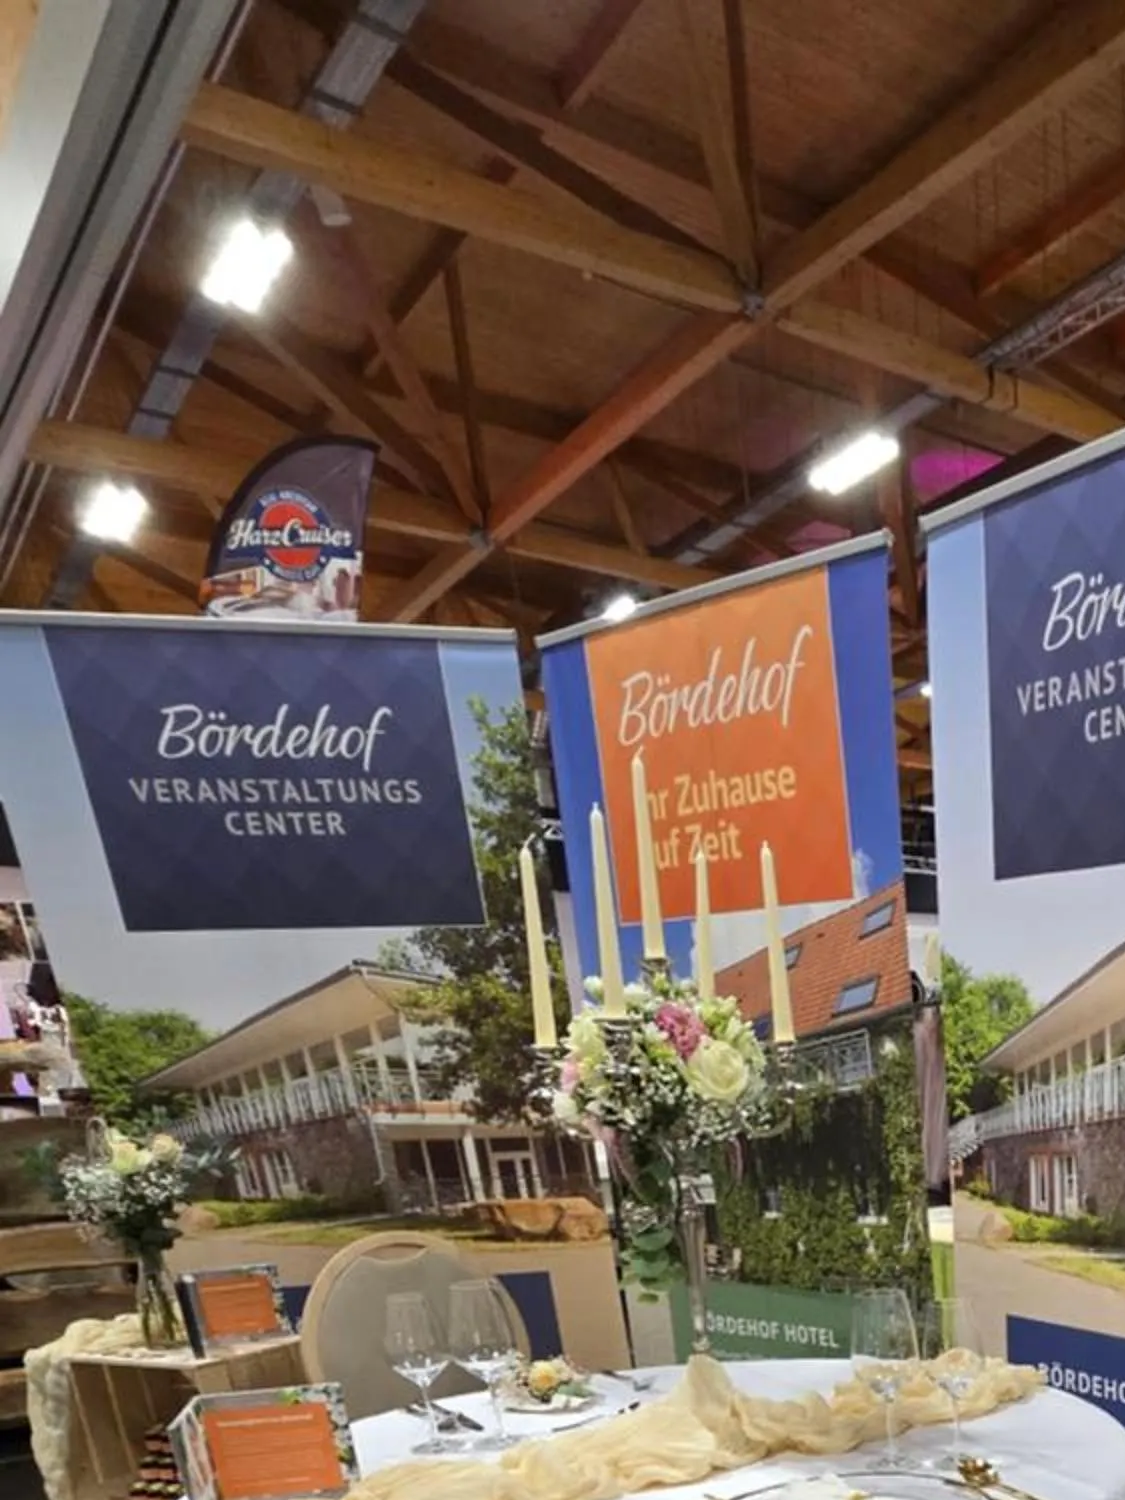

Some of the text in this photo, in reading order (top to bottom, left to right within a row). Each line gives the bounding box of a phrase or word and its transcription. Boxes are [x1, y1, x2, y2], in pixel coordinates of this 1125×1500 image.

[618, 624, 814, 747] Bördehof
[157, 703, 393, 772] Bördehof
[128, 777, 423, 805] VERANSTALTUNGS
[673, 764, 798, 817] Zuhause
[224, 810, 347, 836] CENTER
[653, 818, 743, 871] uf Zeit
[706, 1311, 841, 1349] ÖRDEHOF HOTEL
